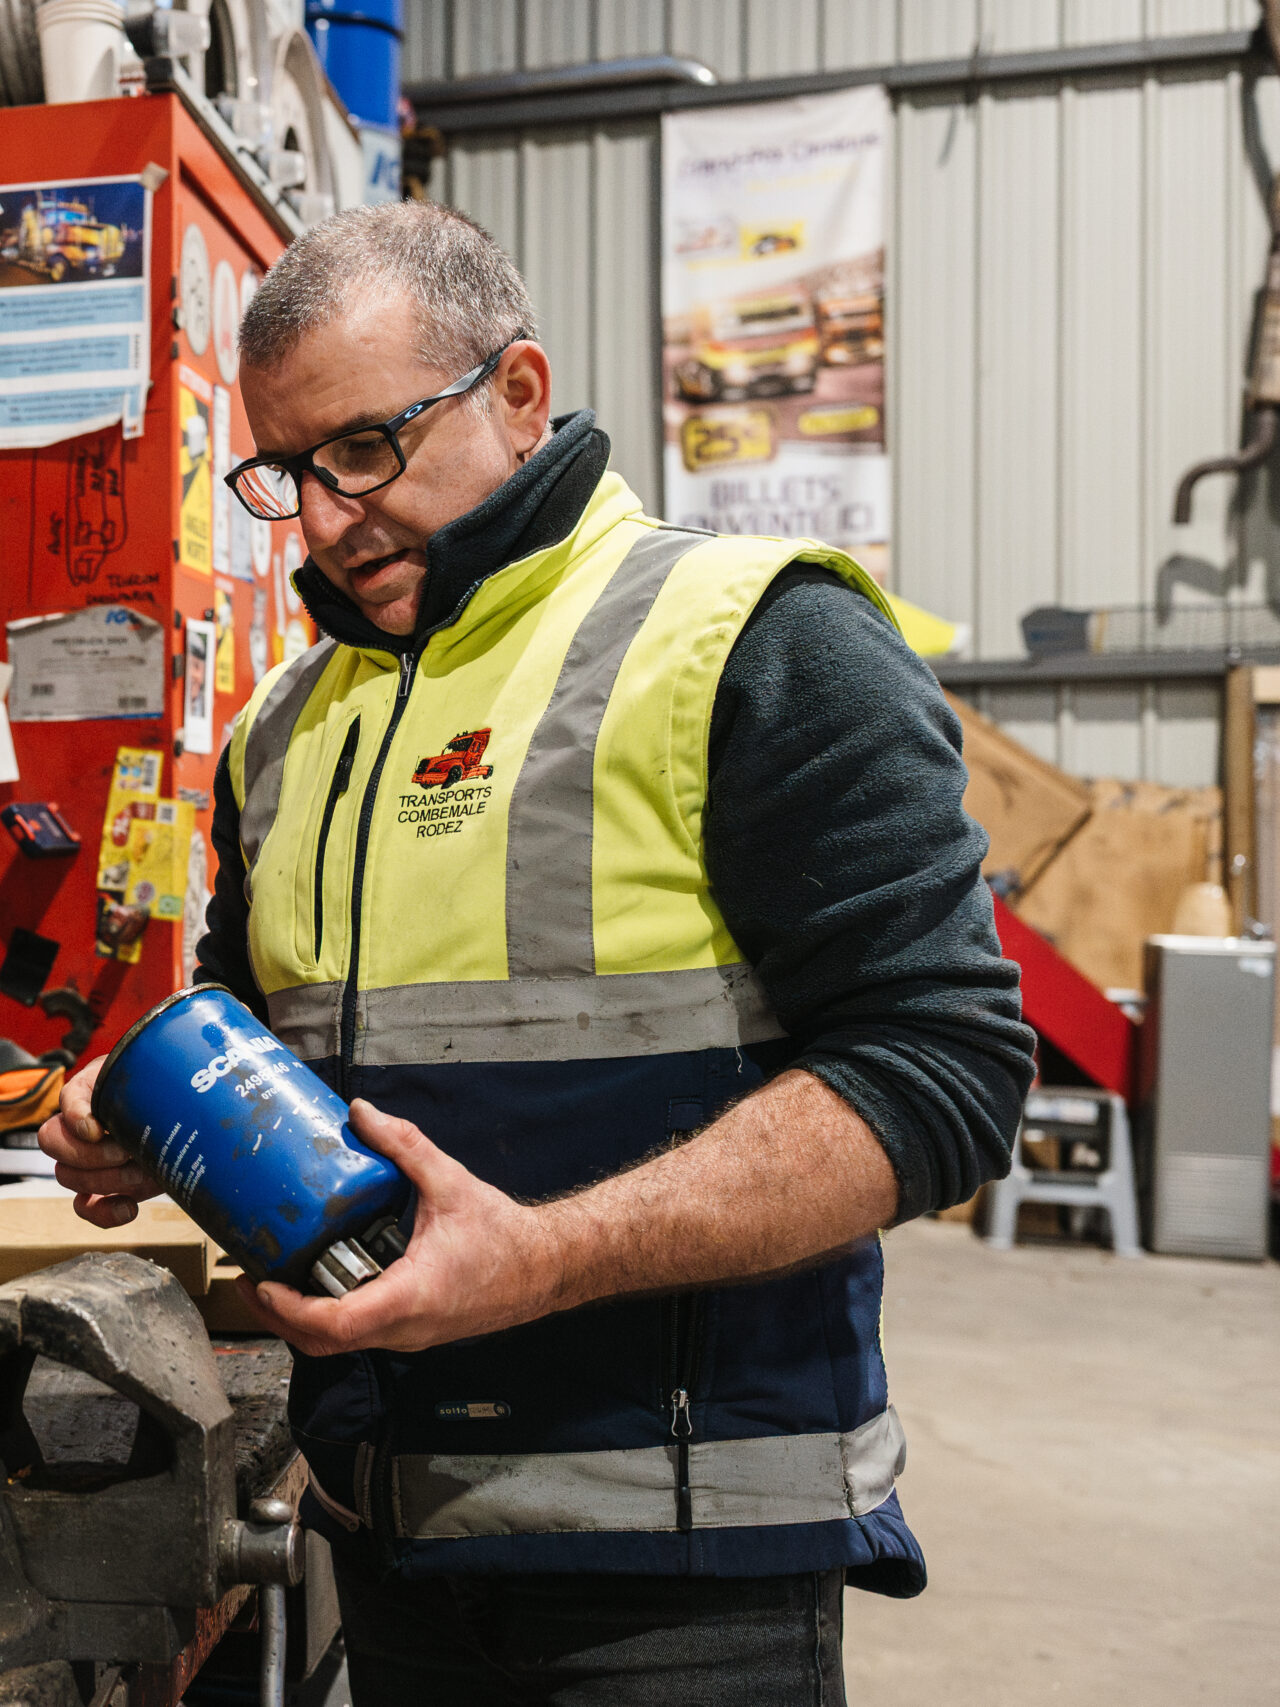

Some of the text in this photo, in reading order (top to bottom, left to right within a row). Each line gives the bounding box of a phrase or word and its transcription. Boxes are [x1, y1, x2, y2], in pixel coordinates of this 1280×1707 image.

[398, 786, 492, 807] TRANSPORTS
[397, 801, 486, 823] COMBEMALE
[416, 820, 464, 838] RODEZ
[190, 1035, 284, 1093] SCANIA
[235, 1061, 290, 1098] 249846
